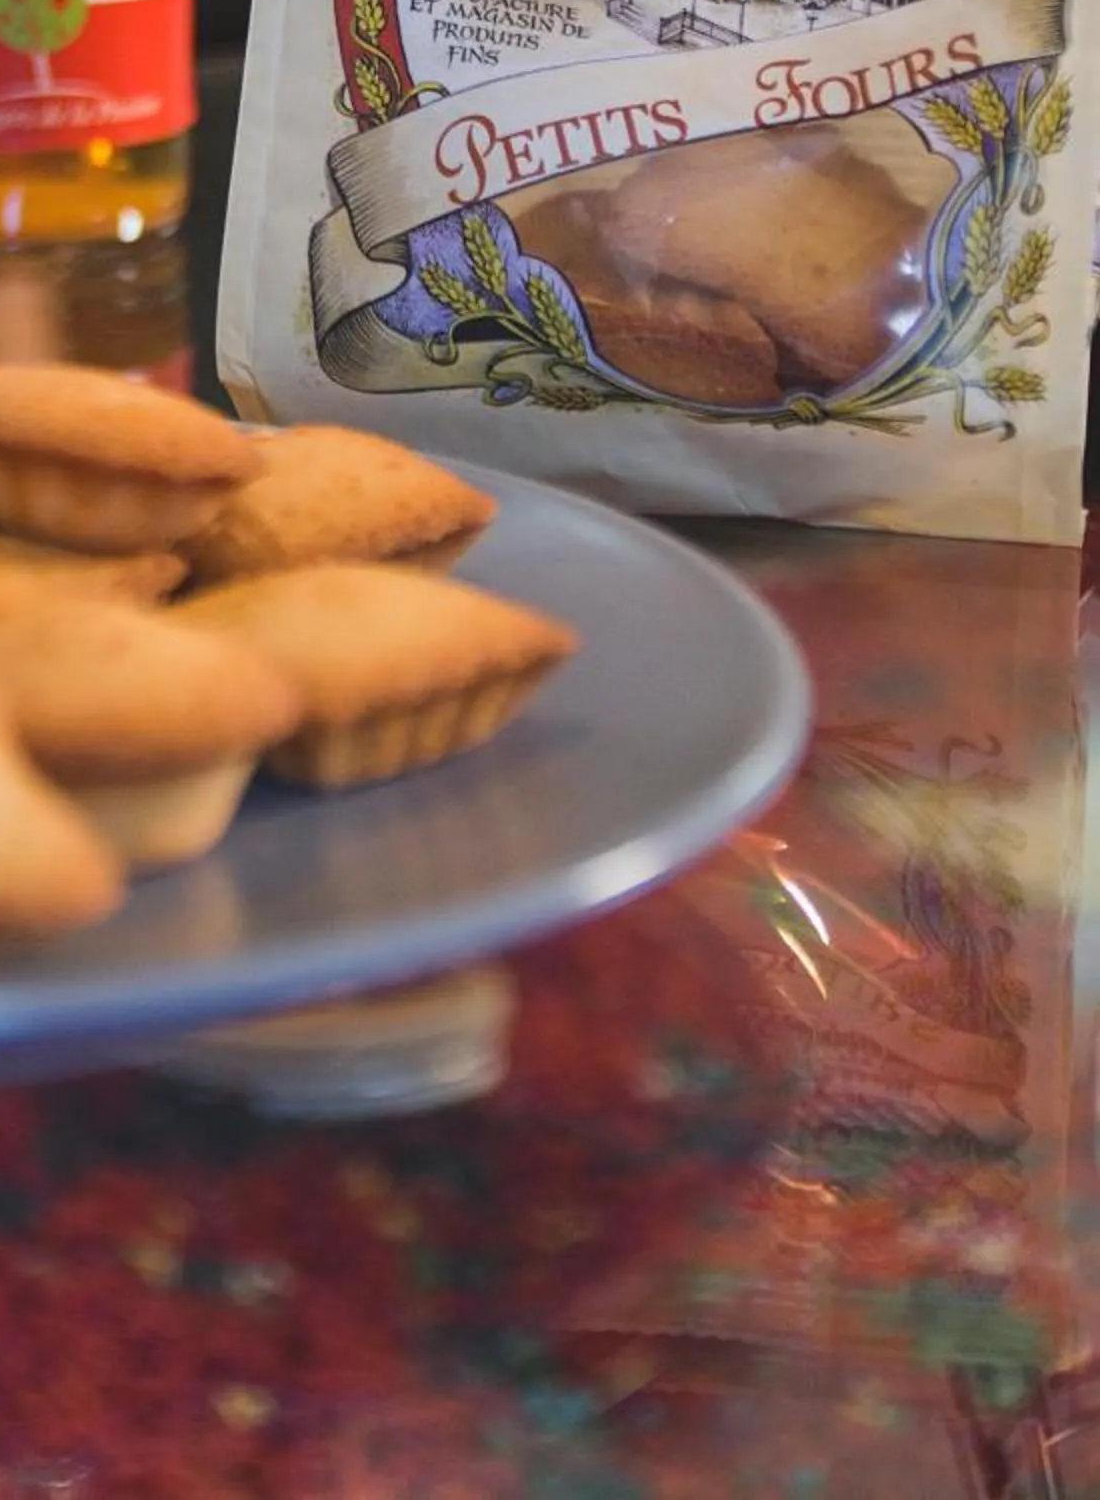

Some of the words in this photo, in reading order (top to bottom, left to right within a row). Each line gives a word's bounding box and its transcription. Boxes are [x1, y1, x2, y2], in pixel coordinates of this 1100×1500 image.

[433, 19, 540, 50] PRODUITS
[446, 2, 555, 35] MAGASIN
[561, 22, 591, 39] DE
[448, 43, 500, 68] FINS
[434, 98, 690, 205] PETITS
[753, 32, 983, 130] FOURS
